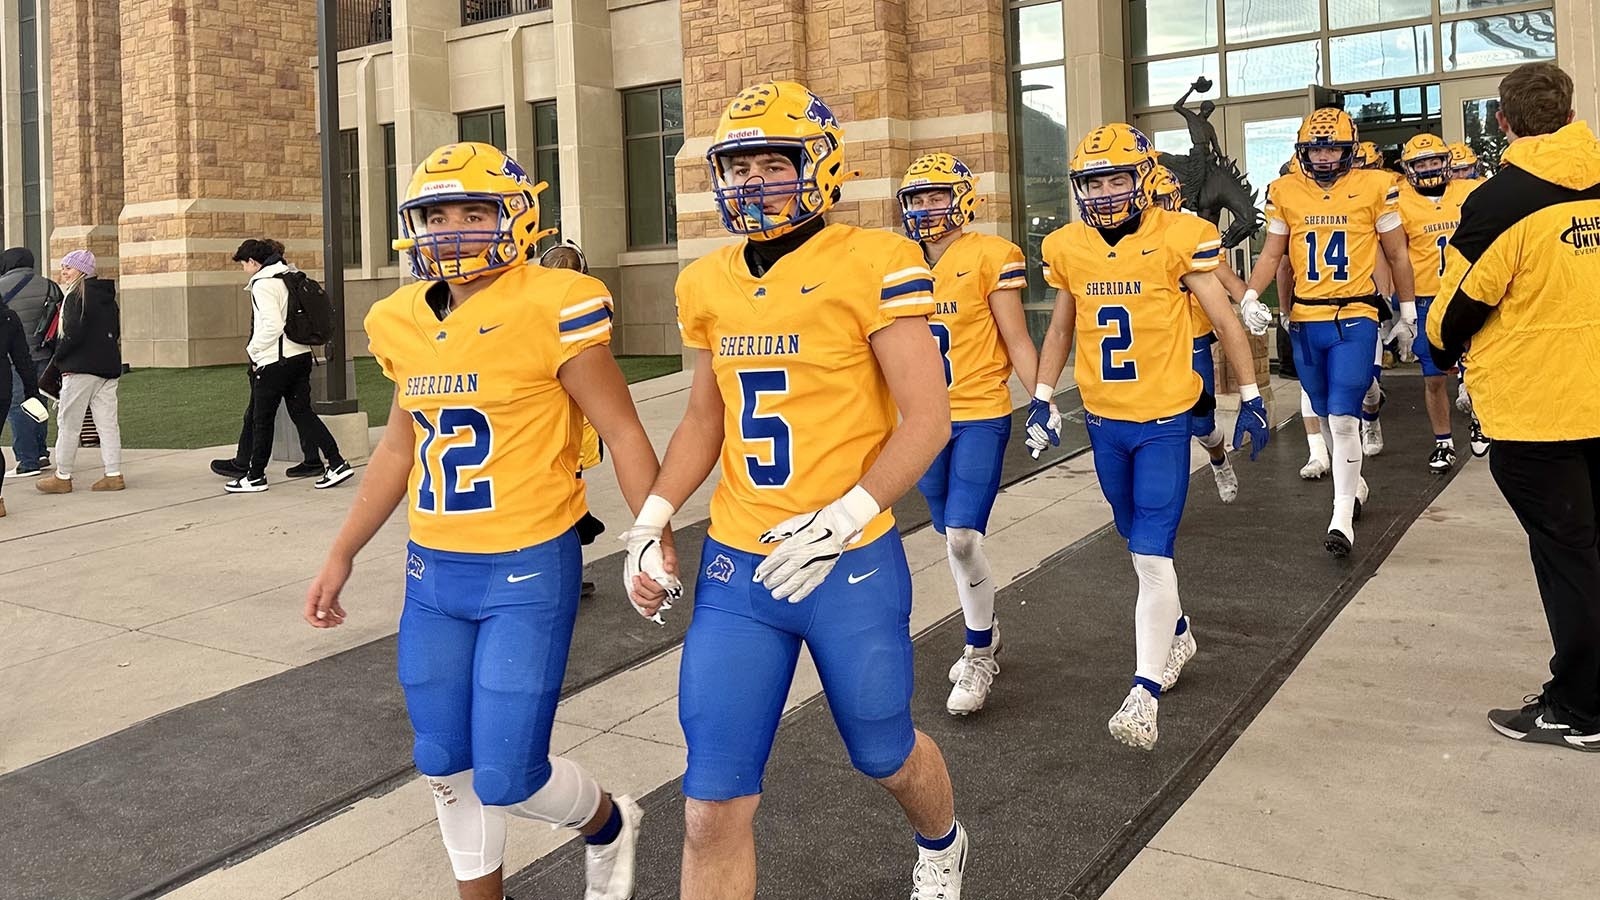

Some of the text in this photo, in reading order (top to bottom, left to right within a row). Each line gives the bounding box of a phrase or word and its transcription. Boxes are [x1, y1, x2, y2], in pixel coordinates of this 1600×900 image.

[728, 130, 759, 139] Riddell
[1304, 215, 1348, 225] SHERIDAN
[1304, 229, 1350, 282] 14
[1574, 247, 1598, 256] EVENT
[1086, 281, 1141, 296] SHERIDAN
[719, 334, 800, 356] SHERIDAN
[1096, 304, 1139, 382] 2
[405, 373, 479, 396] SHERIDAN
[736, 368, 794, 488] 5
[410, 405, 496, 514] 12
